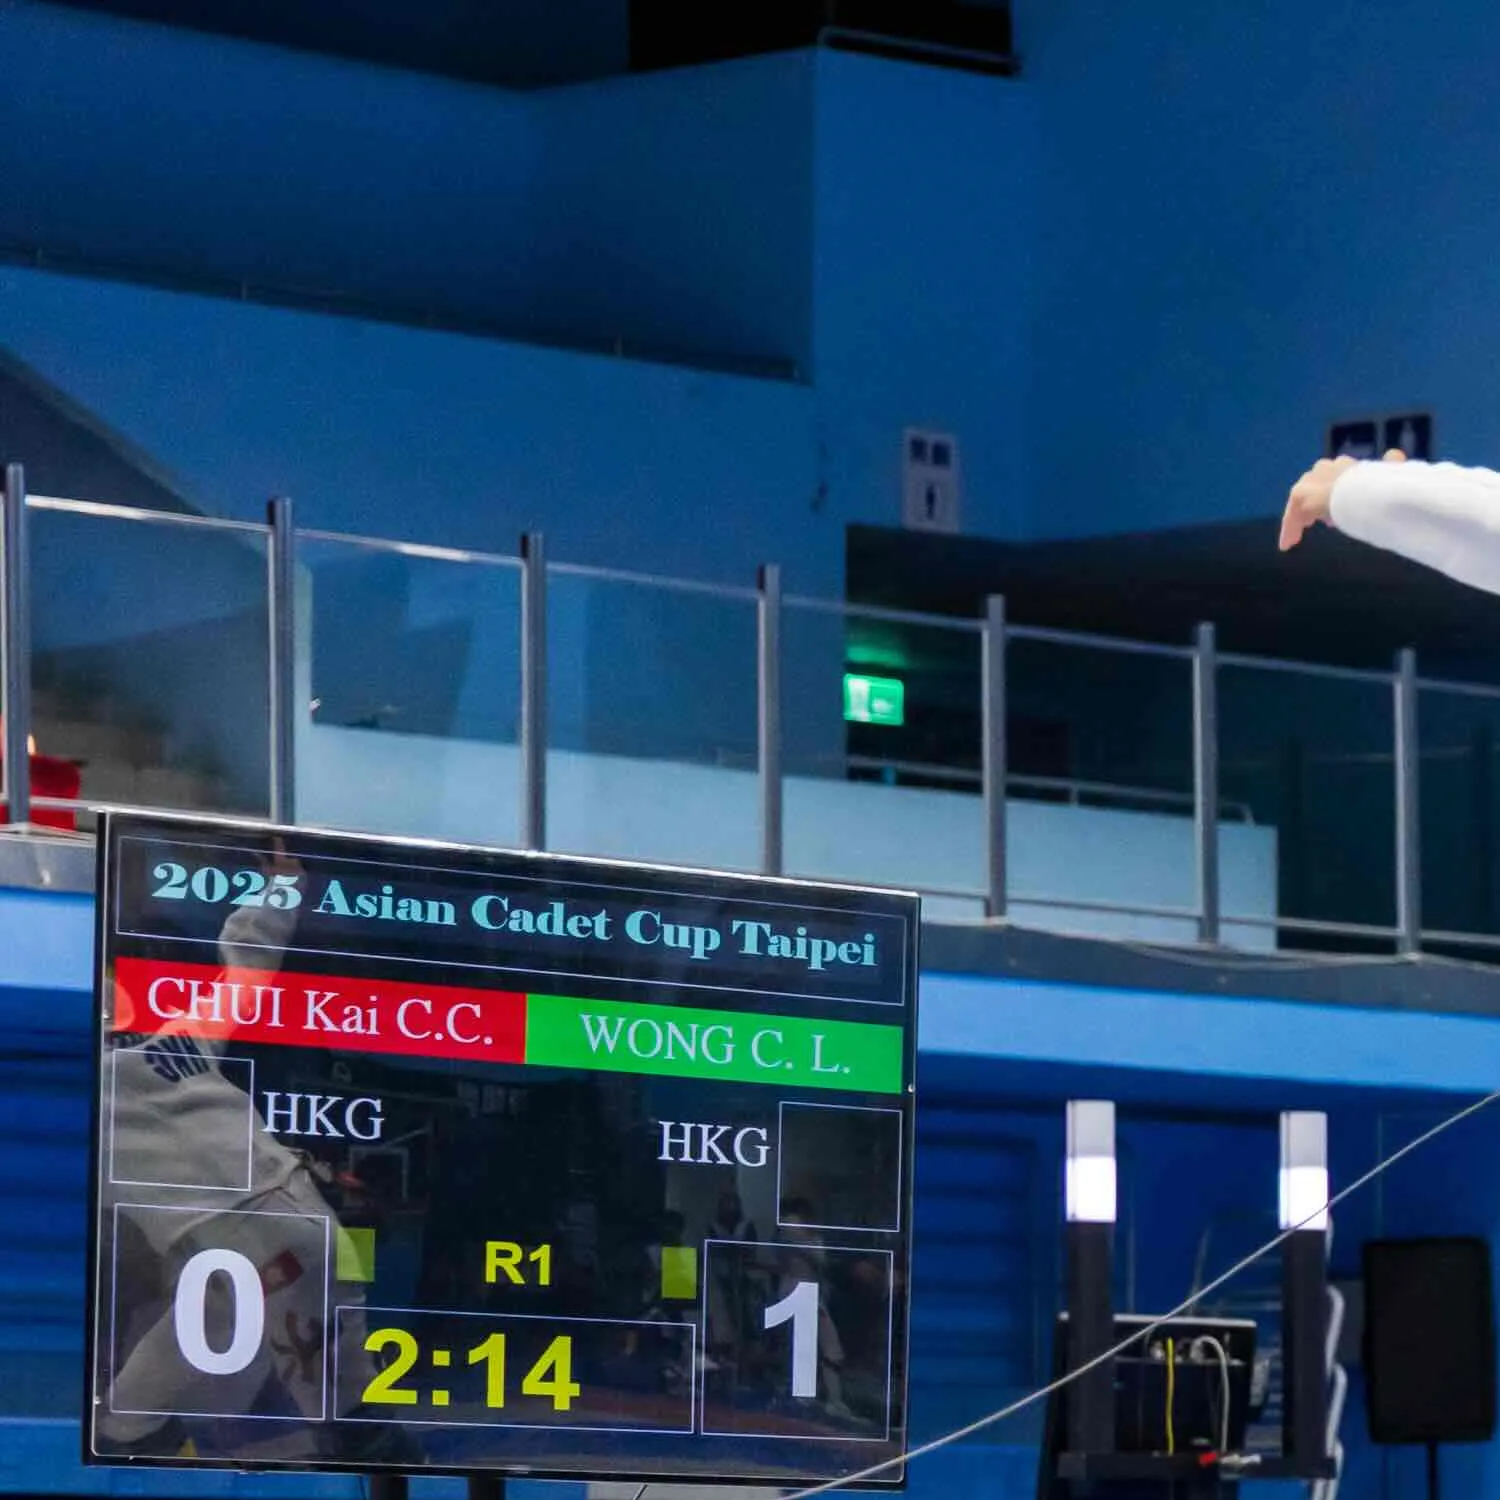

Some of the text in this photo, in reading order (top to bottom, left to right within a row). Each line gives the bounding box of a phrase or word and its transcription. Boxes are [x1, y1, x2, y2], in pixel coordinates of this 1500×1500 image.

[151, 862, 878, 971] 2025 Asian Cadet Cup Taipei
[147, 975, 494, 1047] CHUI Kai C.C.
[579, 1013, 851, 1074] WONG C. L.
[263, 1090, 386, 1142] HKG
[658, 1120, 770, 1169] HKG
[484, 1242, 553, 1287] R1
[173, 1249, 266, 1377] 0
[763, 1281, 821, 1398] 1
[361, 1327, 581, 1412] 2:14
